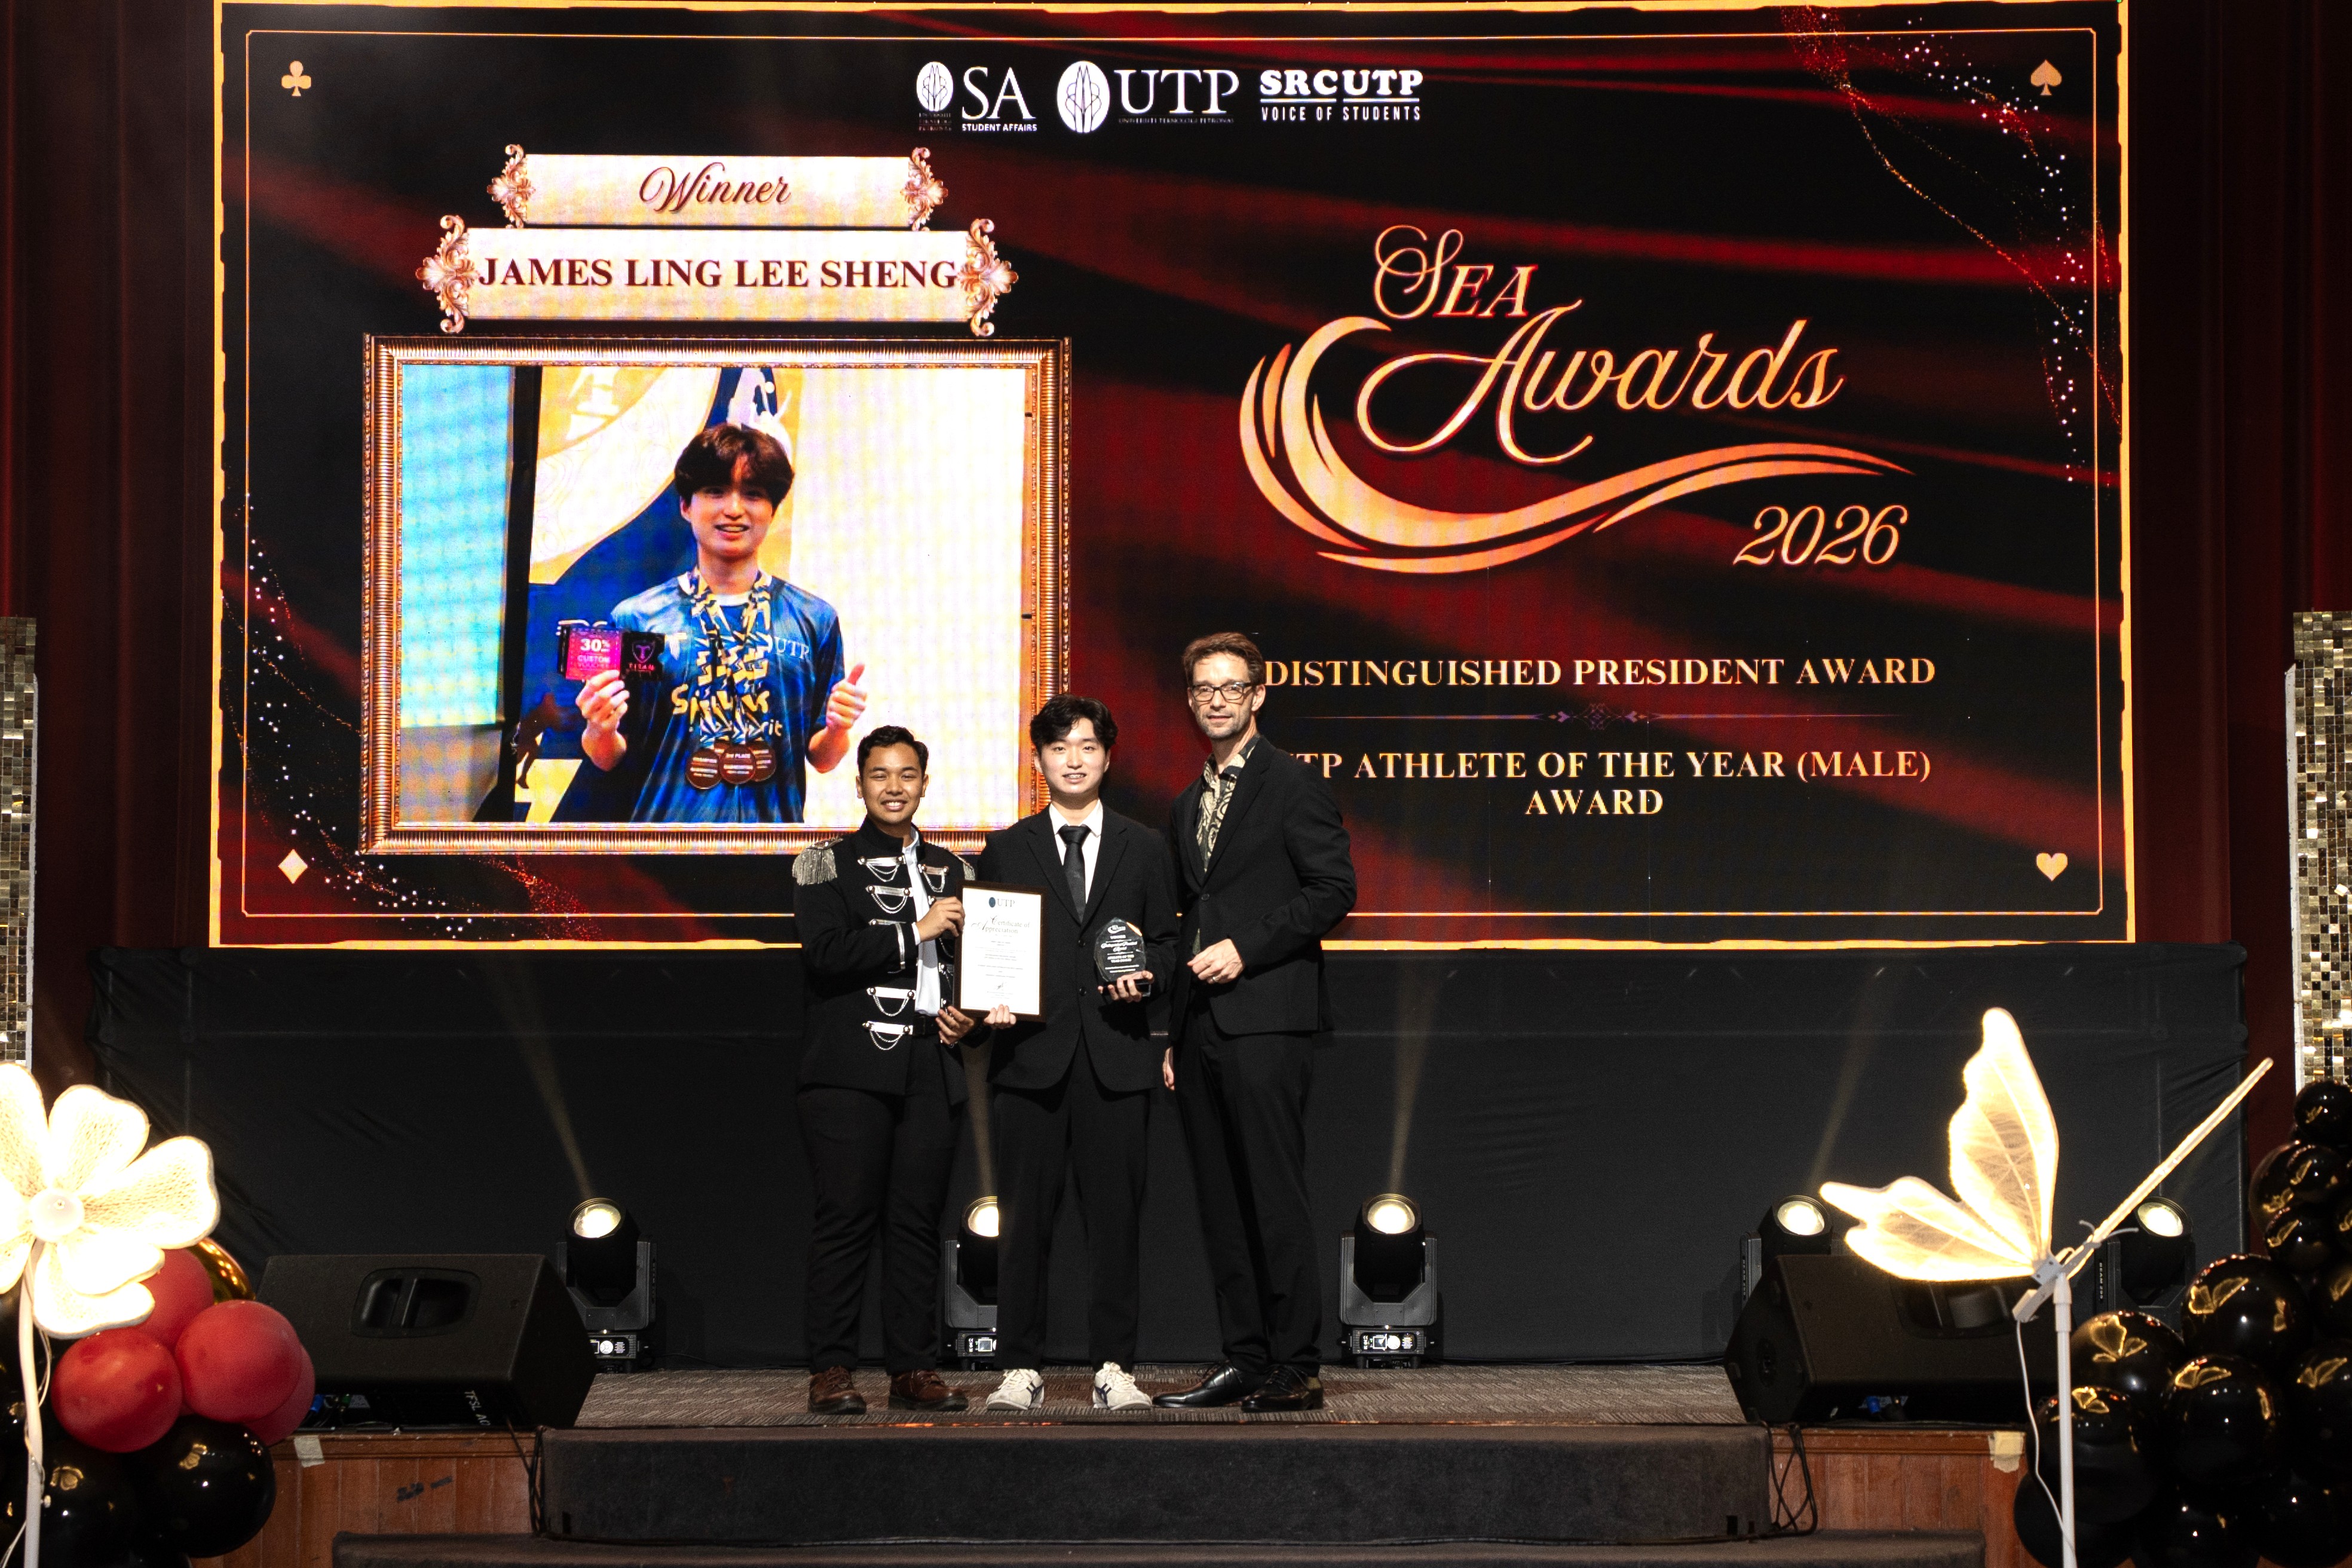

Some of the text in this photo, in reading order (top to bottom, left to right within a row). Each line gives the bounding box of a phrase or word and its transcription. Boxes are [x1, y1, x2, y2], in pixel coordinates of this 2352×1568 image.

[1113, 69, 1239, 114] UTP
[1259, 69, 1423, 96] SRCUTP
[1261, 106, 1420, 121] VOICE OF STUDENTS
[961, 123, 1037, 132] STUDENT AFFAIRS
[639, 162, 789, 213] Winner
[479, 259, 956, 289] JAMES LING LEE SHENG
[1356, 299, 1845, 464] Awards
[1732, 505, 1909, 565] 2026
[774, 636, 809, 659] UTP
[1264, 658, 1936, 686] DISTINGUISHED PRESIDENT AWARD
[1290, 750, 1931, 783] TP ATHLETE OF THE YEAR (MALE)
[1525, 789, 1663, 815] AWARD
[997, 898, 1015, 907] UTP
[971, 920, 1018, 933] Appreciation
